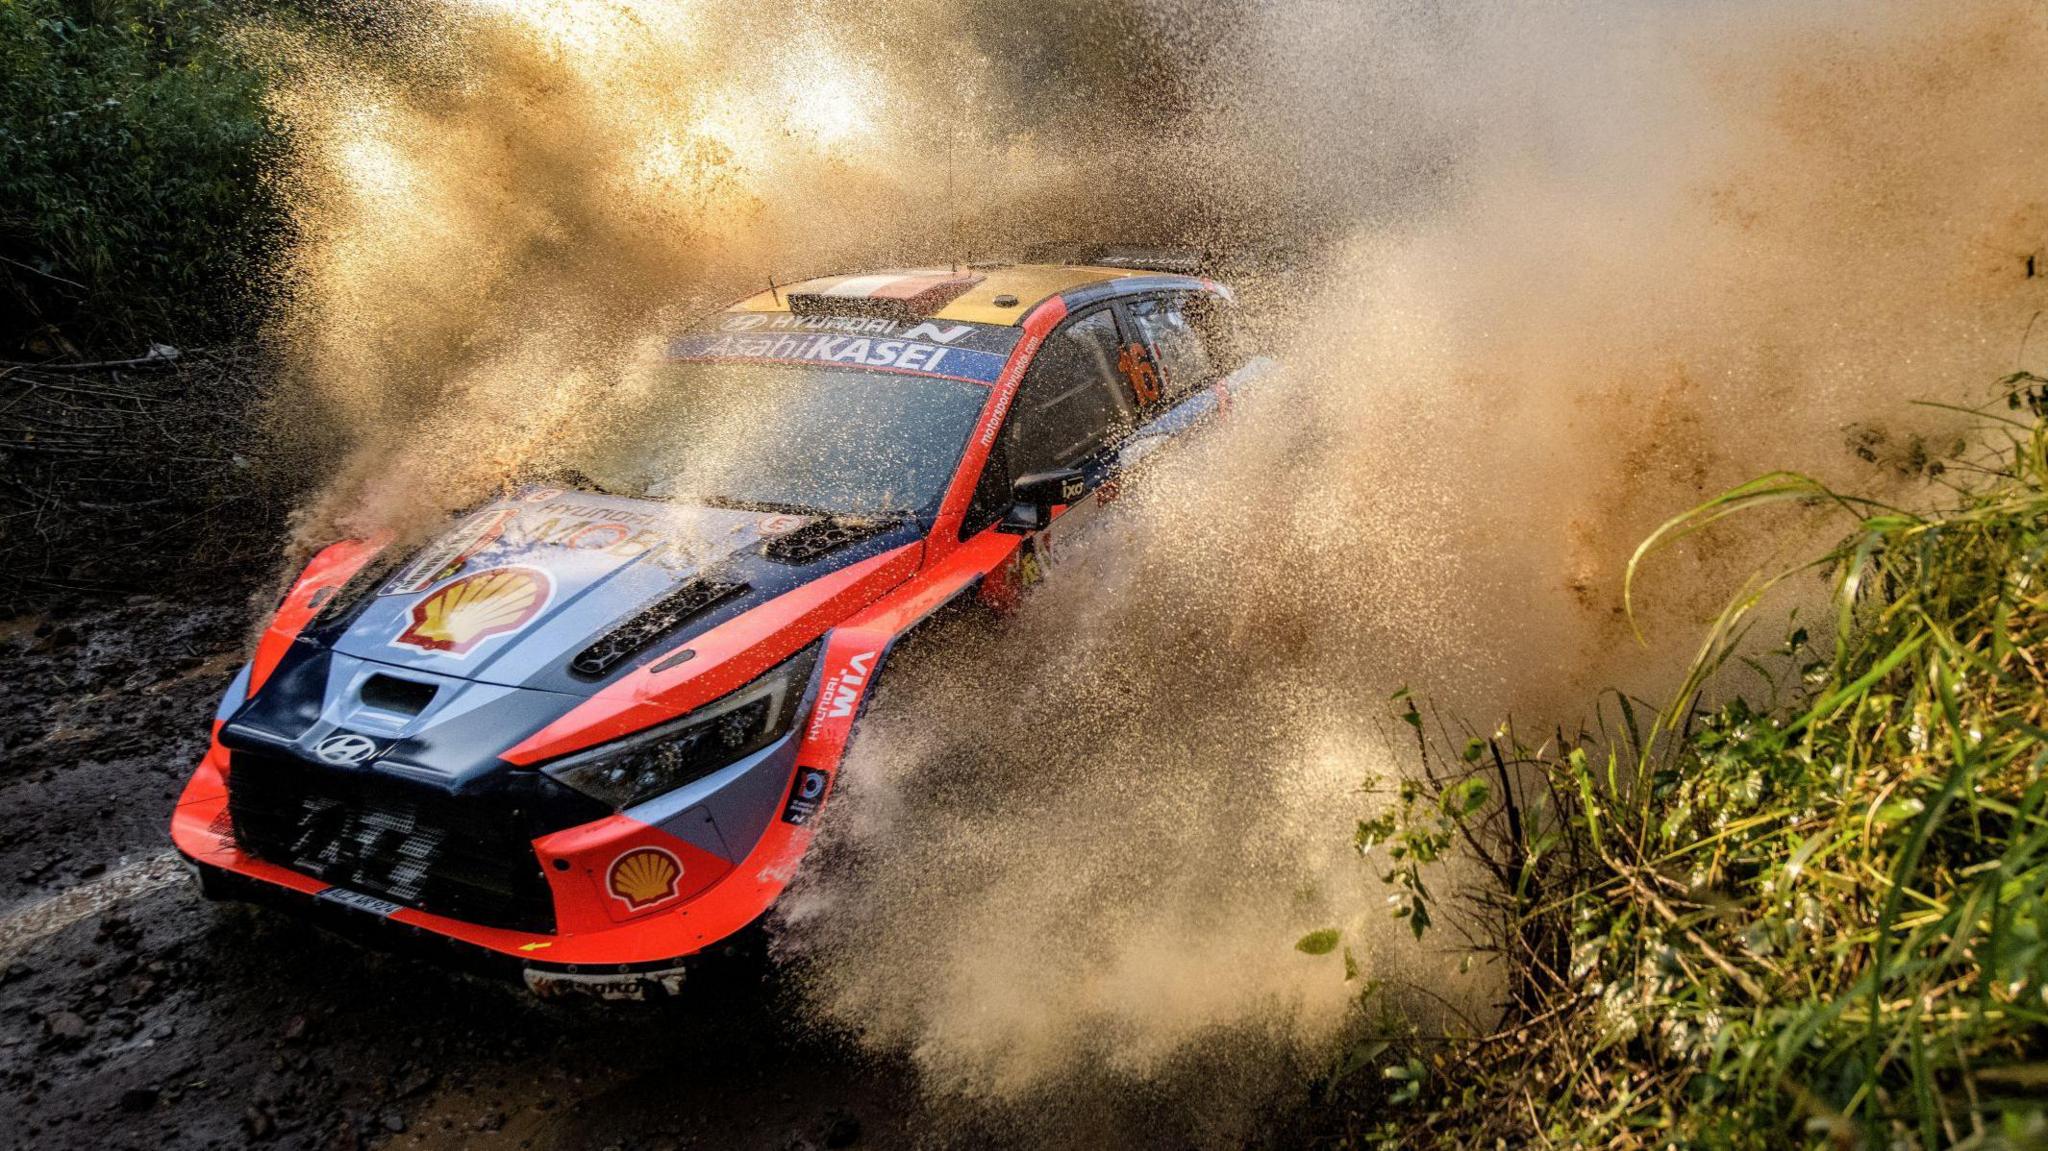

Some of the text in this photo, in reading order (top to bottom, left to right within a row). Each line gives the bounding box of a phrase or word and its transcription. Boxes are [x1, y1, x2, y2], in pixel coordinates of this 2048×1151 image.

[766, 315, 900, 335] HYUNDAI
[1117, 341, 1160, 407] 16
[807, 677, 841, 742] HYUNDAI
